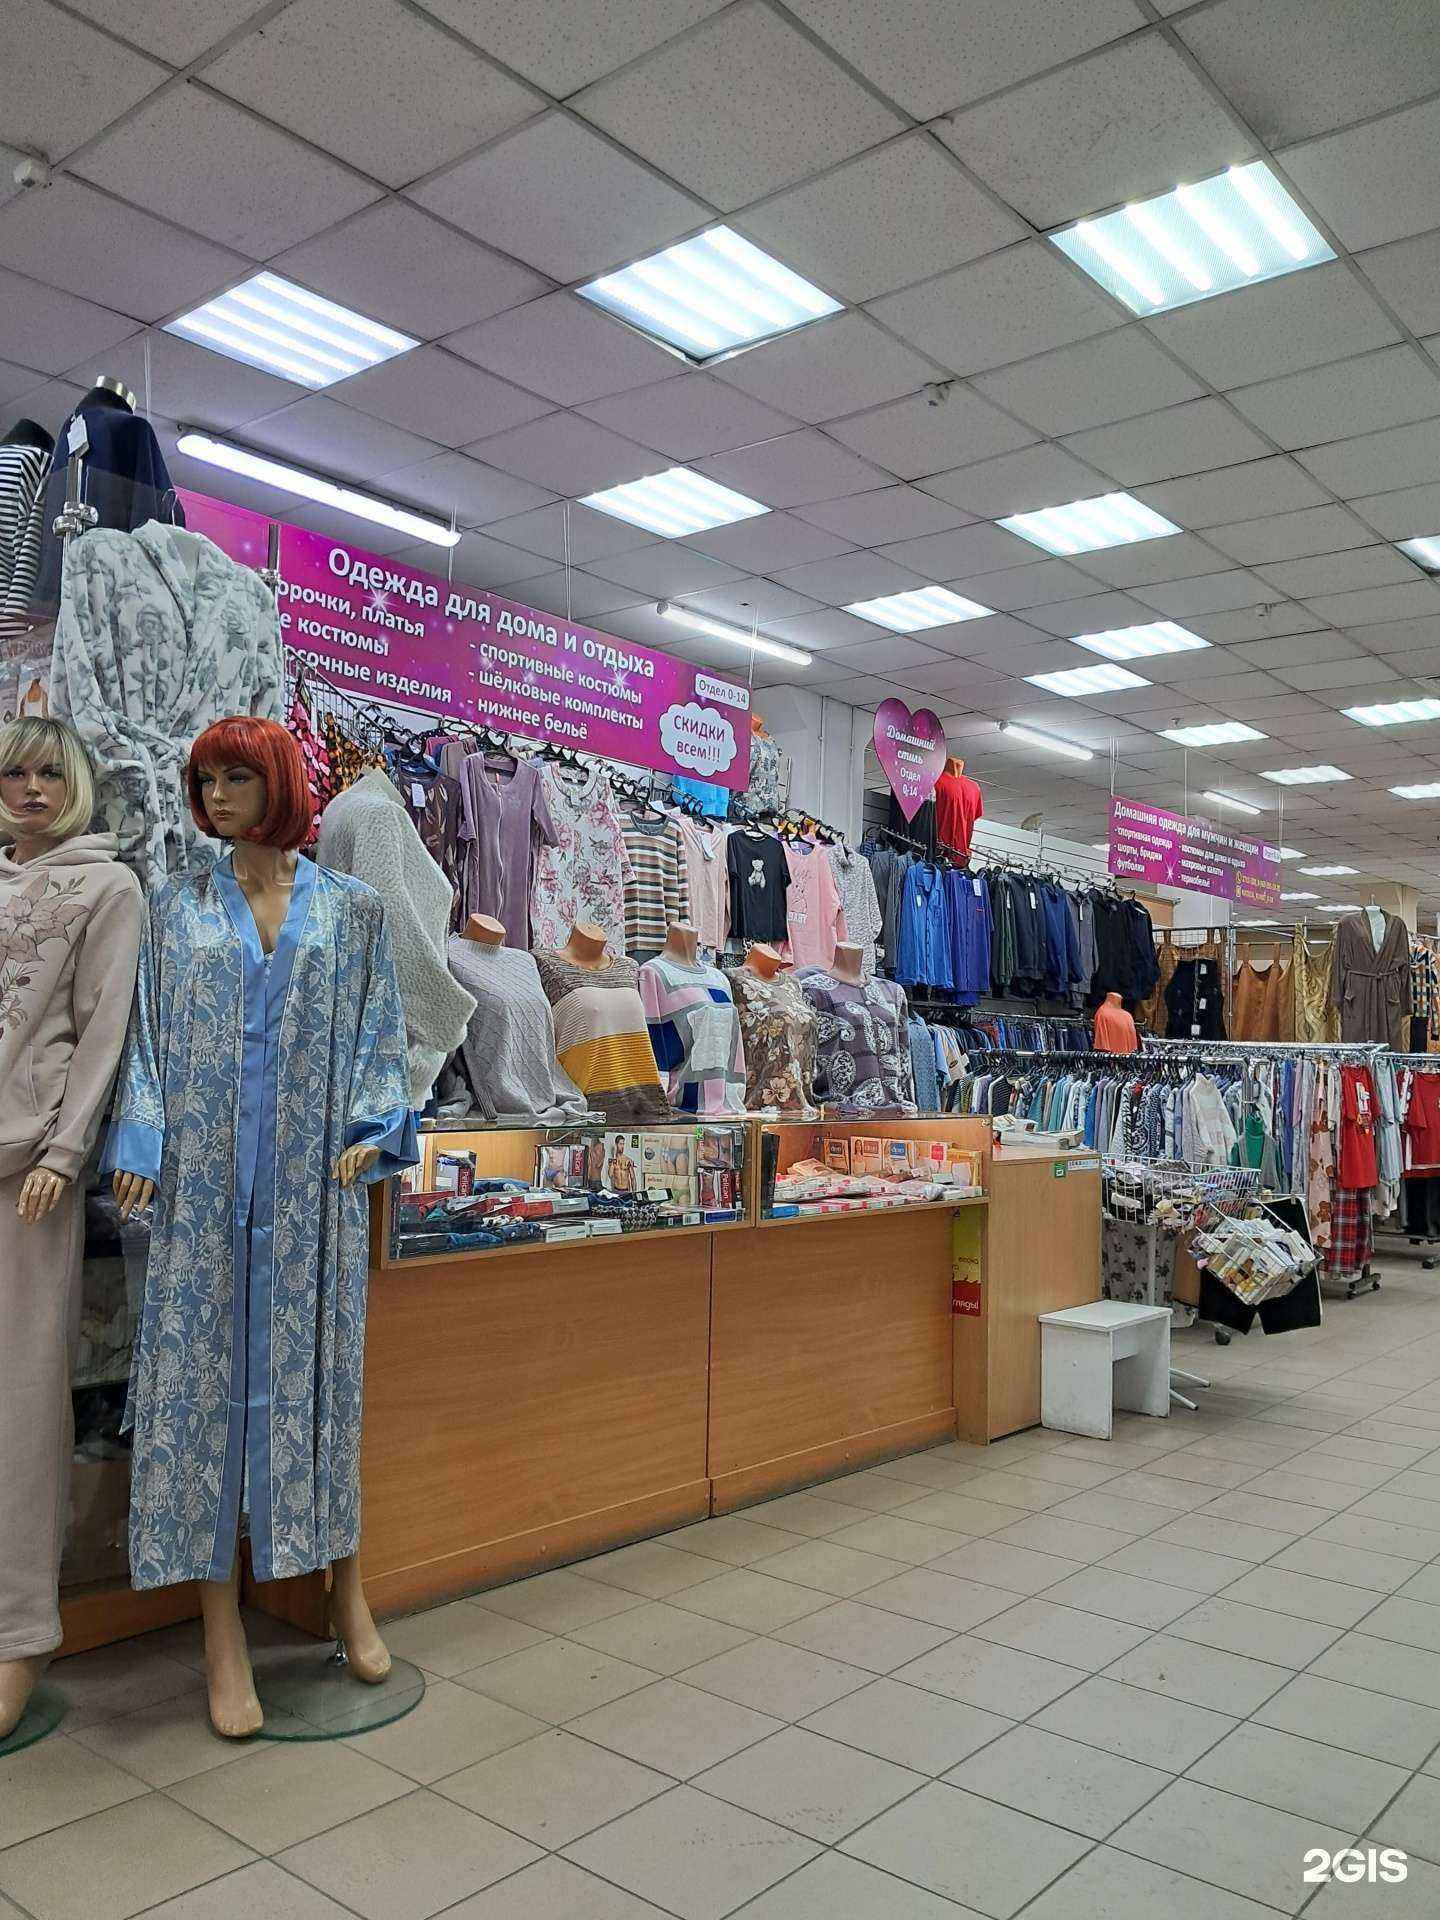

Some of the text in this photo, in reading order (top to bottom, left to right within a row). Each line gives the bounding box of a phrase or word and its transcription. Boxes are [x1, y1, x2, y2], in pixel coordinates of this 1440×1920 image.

[328, 548, 655, 679] Одежда для дома и отдыха
[362, 605, 425, 638] платья
[297, 617, 389, 656] костюмы
[376, 669, 452, 703] изделия
[479, 641, 574, 684] спортивные
[578, 671, 643, 706] костюмы
[479, 669, 561, 706] шёлковые
[564, 692, 644, 730] комплекты
[699, 679, 726, 698] Отдел
[477, 698, 541, 728] нижнее
[544, 712, 588, 740] бельё
[673, 714, 725, 742] СКИДКИ
[676, 739, 721, 763] всем!!!
[886, 724, 935, 752] Домашний
[897, 749, 923, 765] стиль
[900, 767, 921, 782] Отдел
[1114, 801, 1157, 826] Домашняя
[1158, 816, 1187, 836] одежда
[1187, 824, 1201, 839] для
[1201, 829, 1228, 847] мужчин
[1117, 827, 1173, 850] спортивная одежда
[1117, 857, 1145, 873] футболки
[1140, 846, 1163, 861] бриджи
